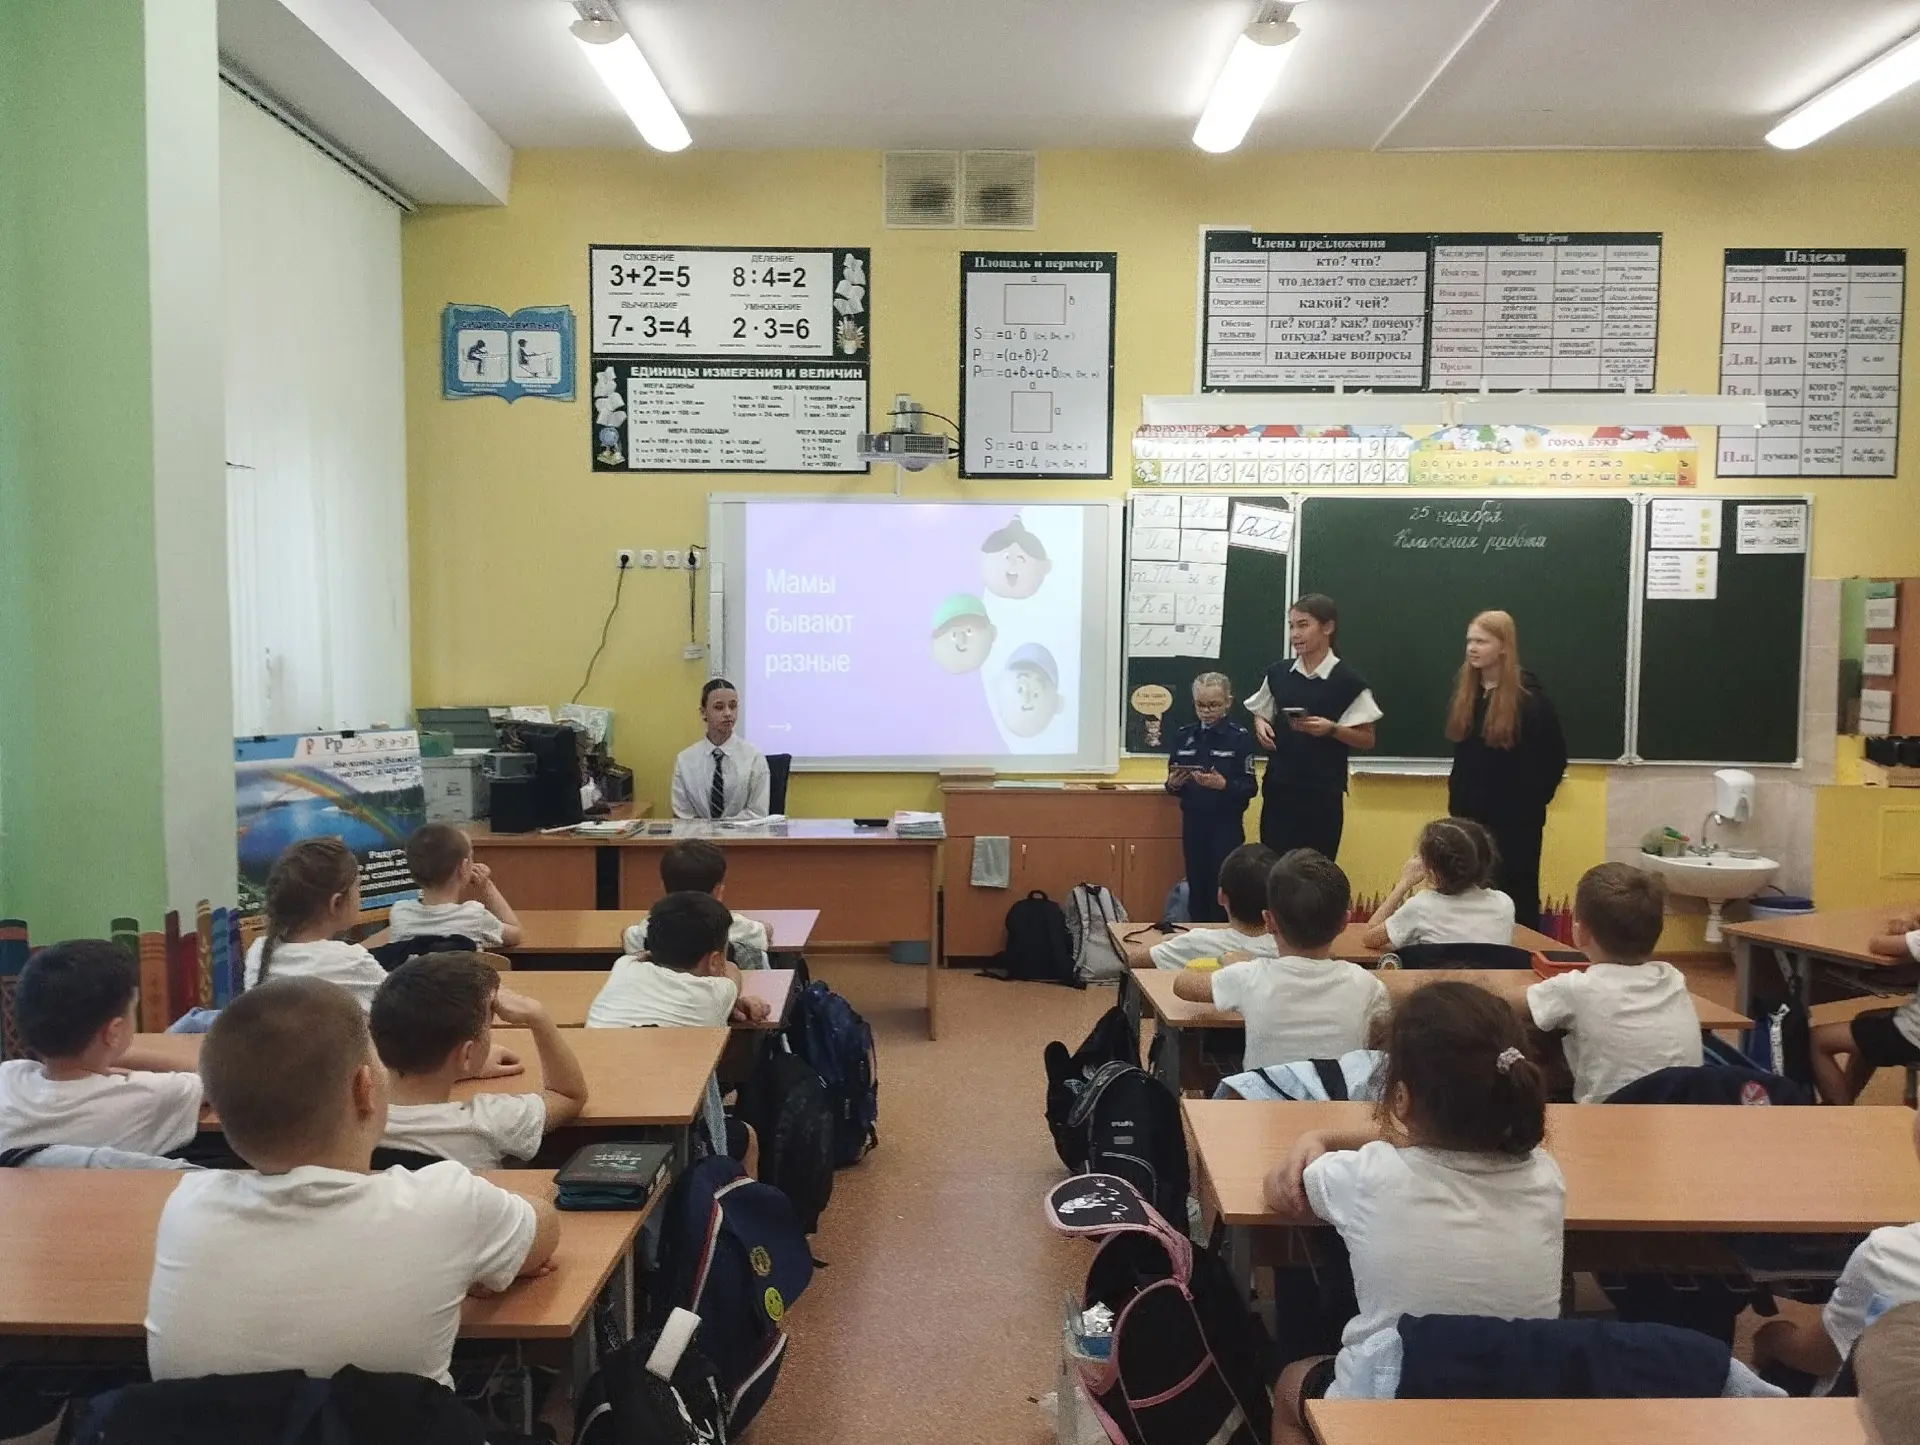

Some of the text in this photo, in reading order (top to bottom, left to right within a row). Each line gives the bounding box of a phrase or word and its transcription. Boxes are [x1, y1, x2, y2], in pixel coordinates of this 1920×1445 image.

[1251, 236, 1387, 251] Члены предложения
[623, 253, 675, 262] СЛОЖЕНИЕ
[751, 254, 795, 264] ДЕЛЕНИЕ
[1316, 255, 1381, 267] кто? что?
[1784, 250, 1846, 263] Падежи
[974, 257, 1104, 271] Площадь и периметр
[609, 264, 691, 288] 3+2=5
[1278, 275, 1418, 288] что делает? что сделает?
[1729, 291, 1761, 303] И.п.
[1811, 287, 1842, 297] кто?
[621, 300, 678, 311] ВЫЧИТАНИЕ
[1299, 296, 1390, 310] какой? чей?
[1768, 295, 1797, 304] есть
[1811, 297, 1842, 307] что?
[745, 302, 802, 312] УМНОЖЕНИЕ
[1269, 317, 1422, 331] где? когда? как? почему?
[1730, 321, 1756, 334] Р.п.
[1770, 323, 1793, 333] нет
[1809, 318, 1846, 329] кого?
[1280, 331, 1409, 344] откуда? зачем? куда?
[1809, 329, 1846, 340] чего?
[1274, 350, 1412, 363] падежные вопросы
[1807, 348, 1848, 360] кому?
[1764, 356, 1797, 366] дать
[1806, 359, 1847, 371] чему?
[630, 367, 863, 379] ЕДИНИЦЫ ИЗМЕРЕНИЯ И ВЕЛИЧИН
[1807, 381, 1845, 391] кого?
[1764, 388, 1800, 399] вижу
[1808, 391, 1838, 402] что?
[1808, 411, 1840, 421] кем?
[1808, 422, 1840, 432] чем?
[1547, 439, 1619, 447] ГОРОД БУКВ
[1163, 461, 1181, 482] 11
[1188, 461, 1207, 482] 12
[1213, 461, 1232, 482] 13
[1239, 461, 1256, 482] 14
[1262, 461, 1283, 482] 15
[1287, 461, 1308, 482] 16
[1313, 461, 1333, 482] 17
[1338, 461, 1357, 482] 18
[1362, 461, 1383, 482] 19
[1386, 461, 1406, 482] 20
[1408, 500, 1505, 532] 25 ноября
[1393, 524, 1547, 555] Классная работа
[765, 567, 836, 594] Мамы
[764, 607, 855, 634] бывают
[764, 653, 852, 680] разные
